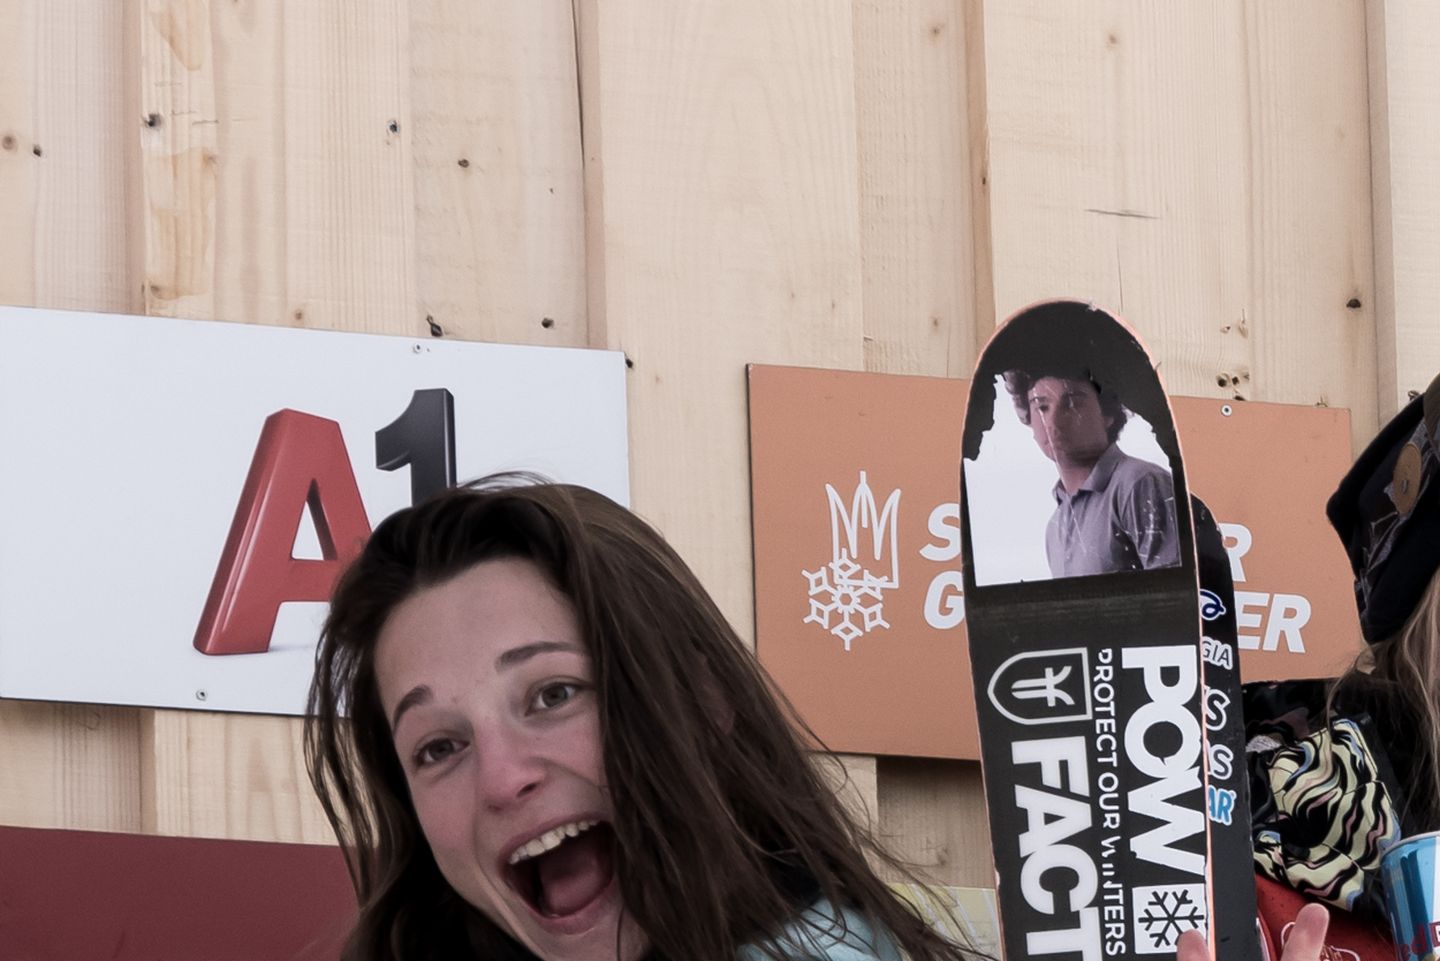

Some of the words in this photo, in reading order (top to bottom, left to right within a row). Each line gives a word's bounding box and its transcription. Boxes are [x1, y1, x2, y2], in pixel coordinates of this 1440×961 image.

[193, 388, 456, 657] A1
[1093, 648, 1118, 767] PROTECT
[1121, 645, 1206, 876] POW
[1098, 772, 1121, 830] OUR
